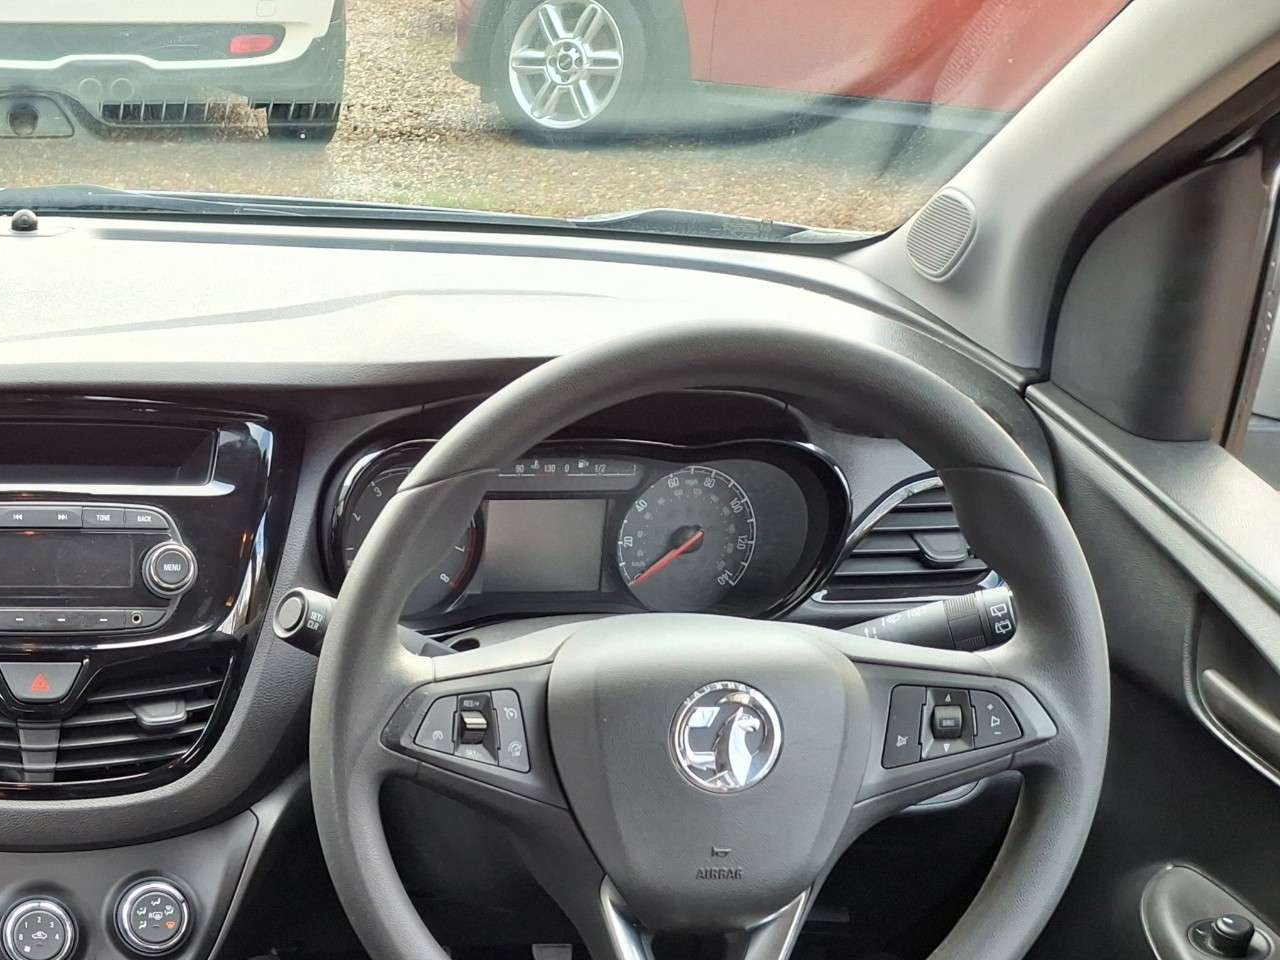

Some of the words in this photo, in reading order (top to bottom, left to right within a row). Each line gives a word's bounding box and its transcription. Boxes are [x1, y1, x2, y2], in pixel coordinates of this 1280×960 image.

[543, 463, 557, 473] 130
[594, 463, 607, 473] 1/2
[667, 477, 680, 489] 60
[703, 476, 716, 489] 80
[635, 500, 648, 512] 40
[730, 497, 743, 513] 100
[95, 514, 112, 522] TONE
[623, 535, 633, 548] 20
[736, 534, 748, 551] 120
[163, 563, 182, 572] MENU
[440, 573, 450, 583] 8
[717, 569, 734, 586] 140
[695, 867, 744, 880] AIRBAG
